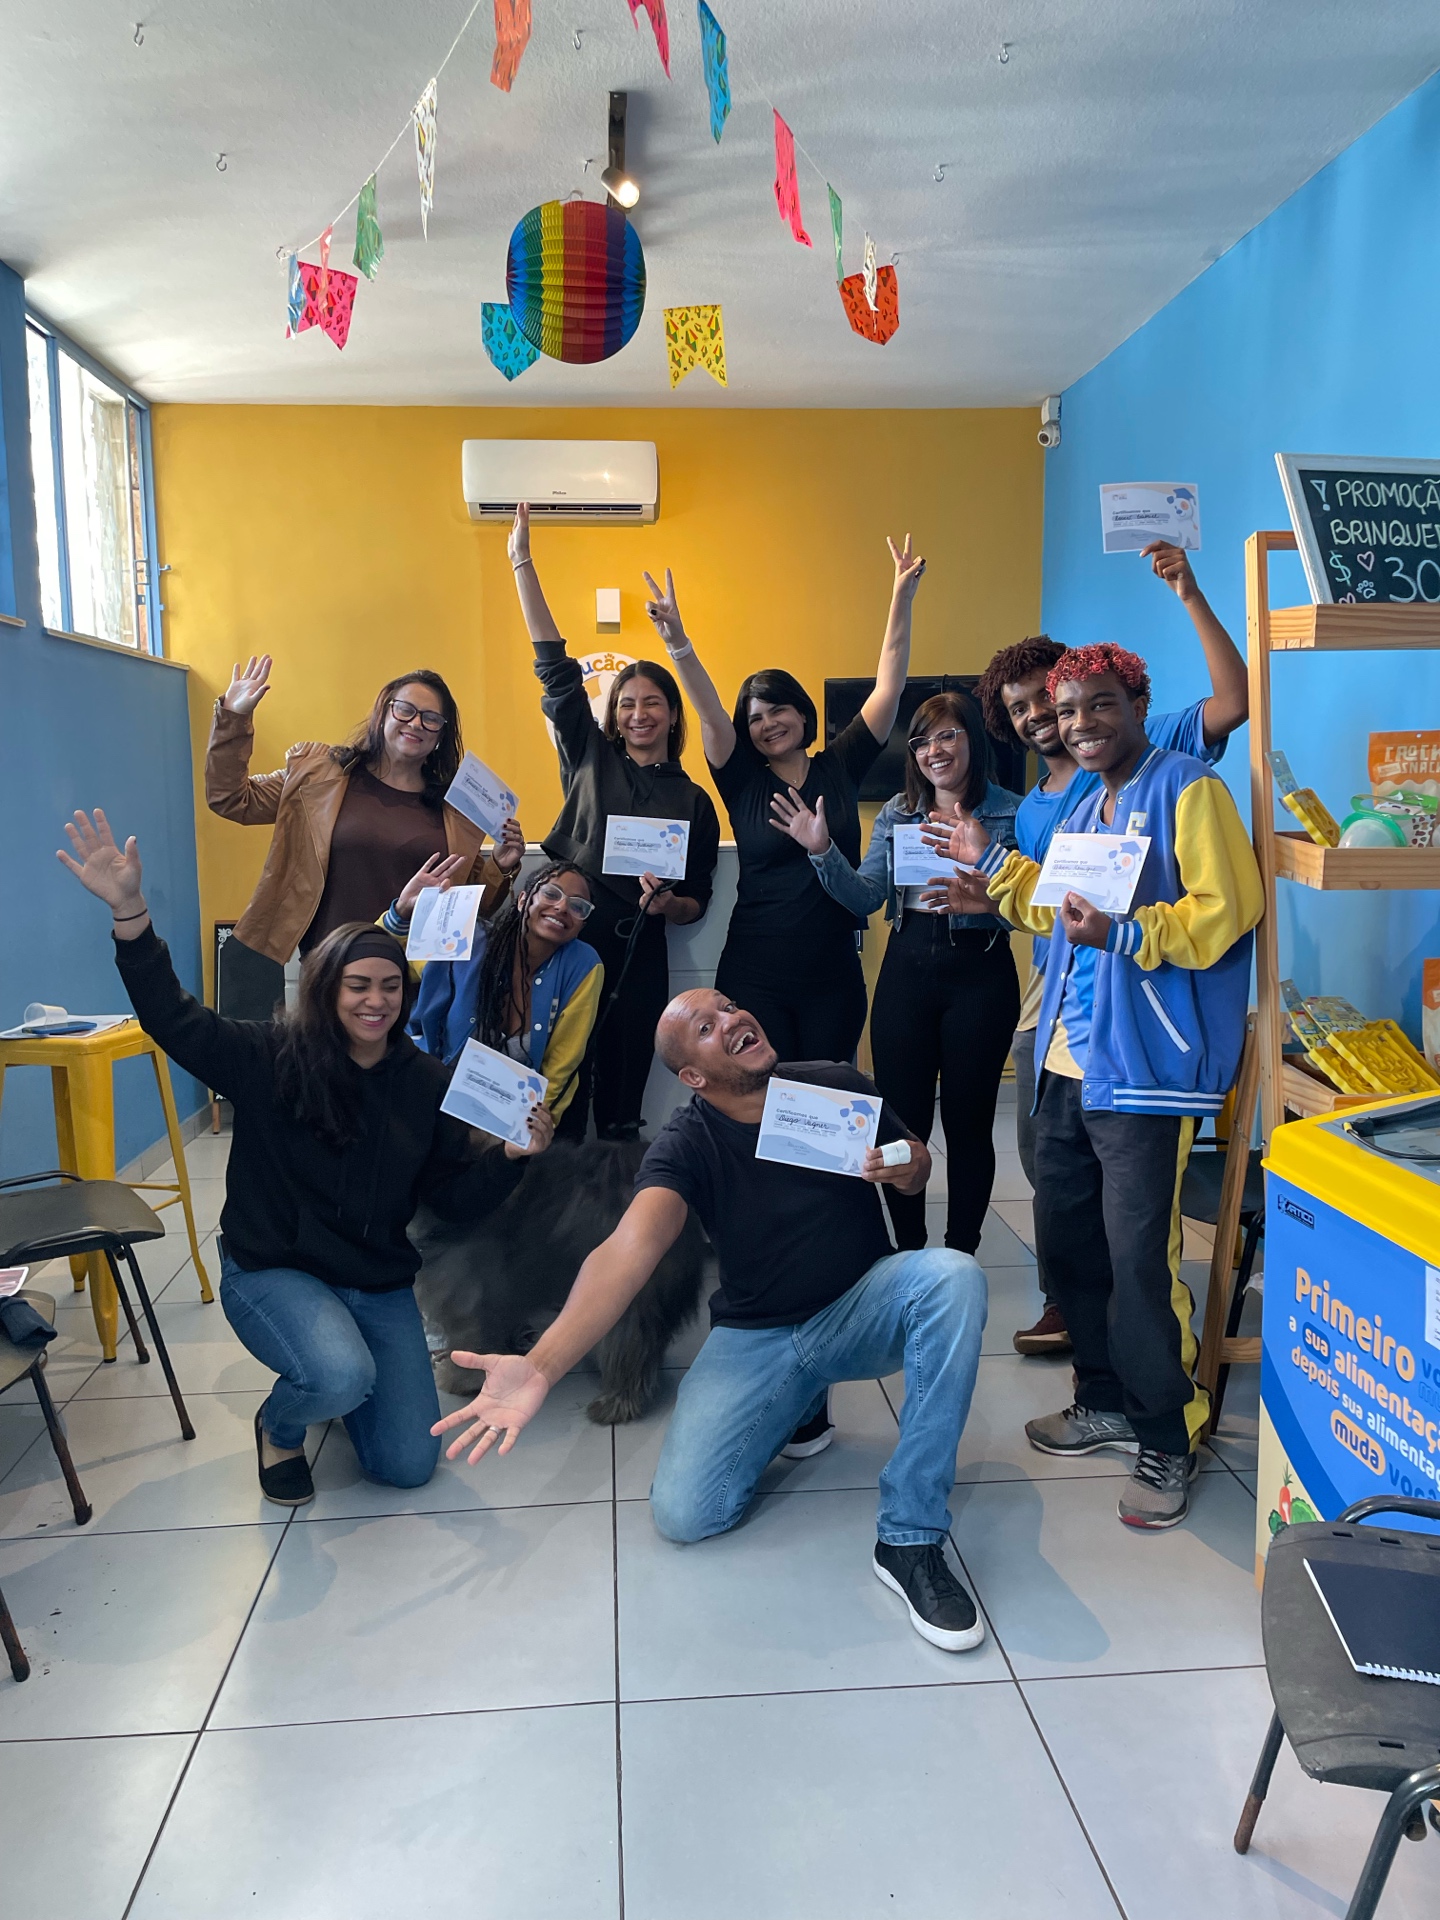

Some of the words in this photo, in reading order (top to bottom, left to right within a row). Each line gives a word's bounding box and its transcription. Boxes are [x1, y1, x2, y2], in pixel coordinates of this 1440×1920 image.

[1384, 557, 1440, 603] 30
[1295, 1266, 1416, 1383] Primeiro
[1288, 1315, 1297, 1332] a
[1304, 1327, 1329, 1357] sua
[1334, 1349, 1440, 1454] alimentaç
[1291, 1345, 1340, 1400] depois
[1341, 1393, 1364, 1420] sua
[1334, 1418, 1380, 1470] muda
